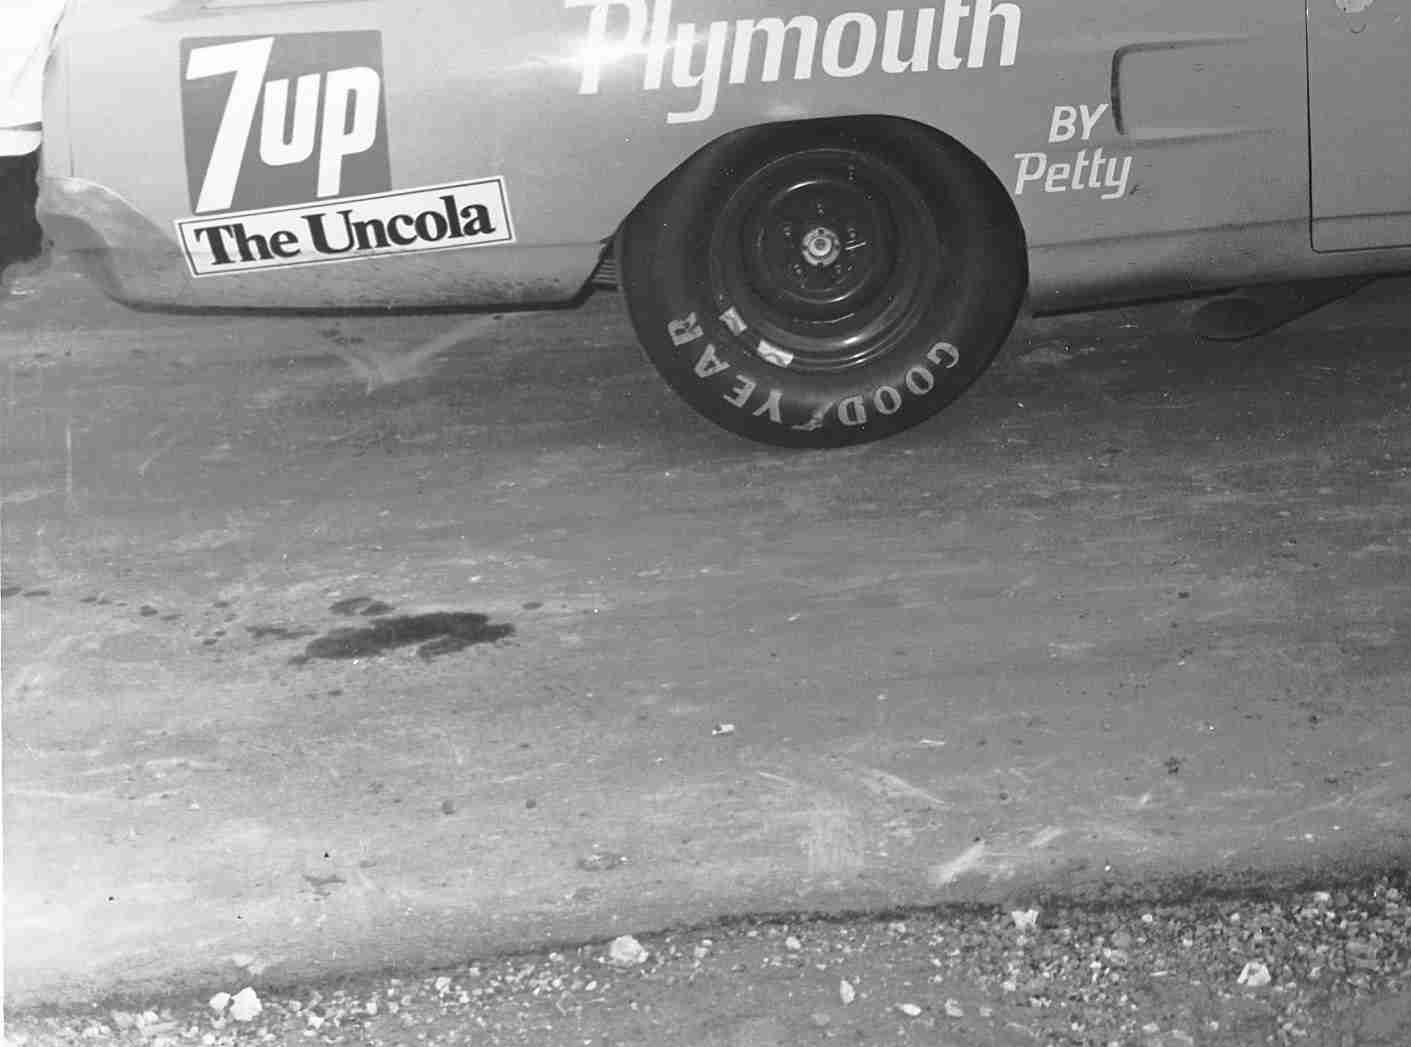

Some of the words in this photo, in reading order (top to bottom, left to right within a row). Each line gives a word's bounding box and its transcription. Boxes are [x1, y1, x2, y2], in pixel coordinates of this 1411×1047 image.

[185, 36, 382, 214] 7up
[1047, 103, 1109, 144] BY
[1014, 149, 1133, 201] Petty
[194, 222, 302, 267] The
[302, 195, 497, 256] Uncola
[666, 311, 960, 432] GOODYEAR
